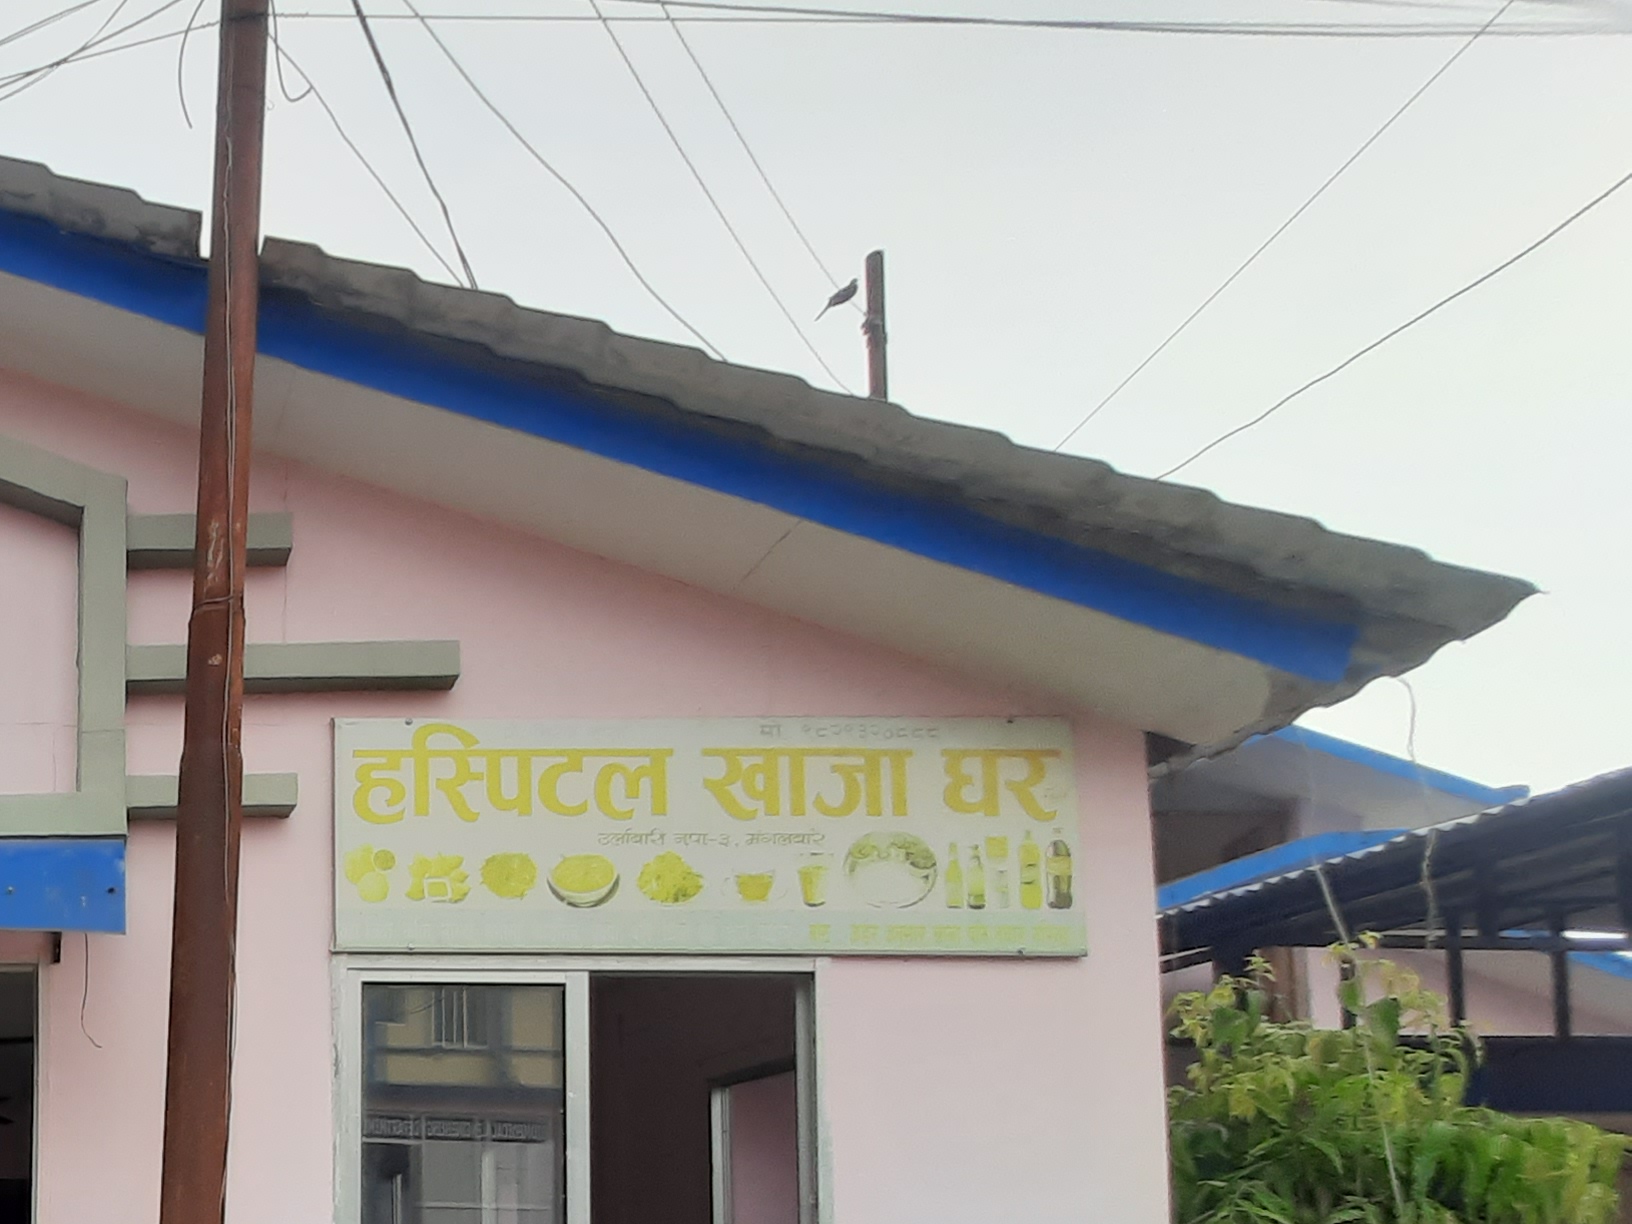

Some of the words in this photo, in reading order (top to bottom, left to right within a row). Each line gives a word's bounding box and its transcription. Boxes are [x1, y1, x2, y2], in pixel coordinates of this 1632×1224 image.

[354, 724, 674, 823] हस्पिटल
[702, 748, 913, 820] खाजा
[942, 749, 1060, 820] घर
